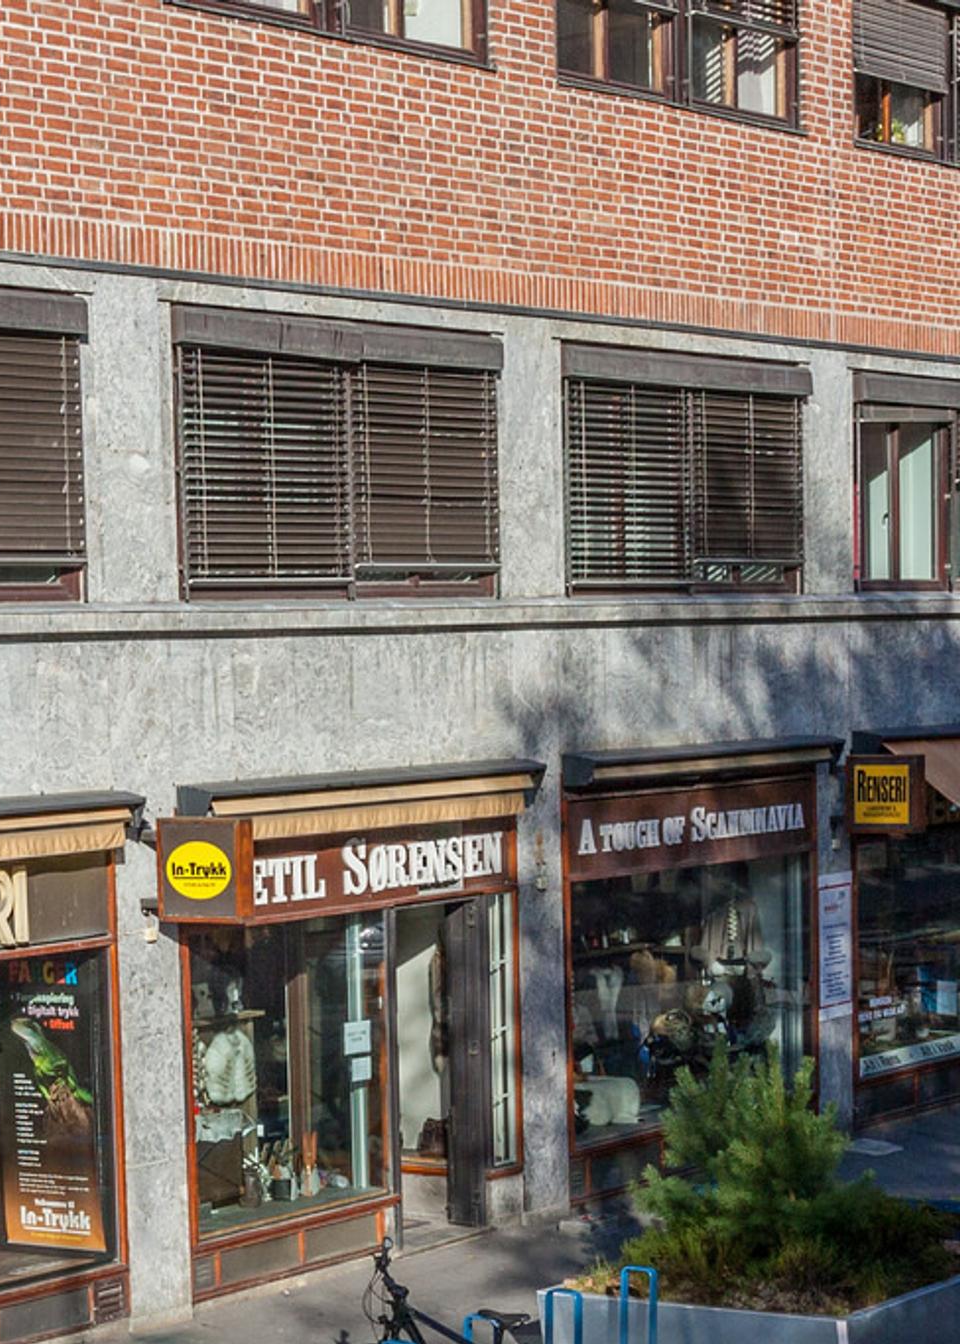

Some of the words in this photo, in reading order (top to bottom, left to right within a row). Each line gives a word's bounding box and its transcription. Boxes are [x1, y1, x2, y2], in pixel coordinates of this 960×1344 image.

[858, 769, 906, 802] RENSERI
[578, 819, 597, 855] A
[600, 819, 660, 852] TOUCH
[663, 816, 686, 846] OF
[691, 803, 805, 842] SCANDINAVIA
[342, 831, 503, 896] SØRENSEN
[20, 1205, 91, 1233] In-Trykk
